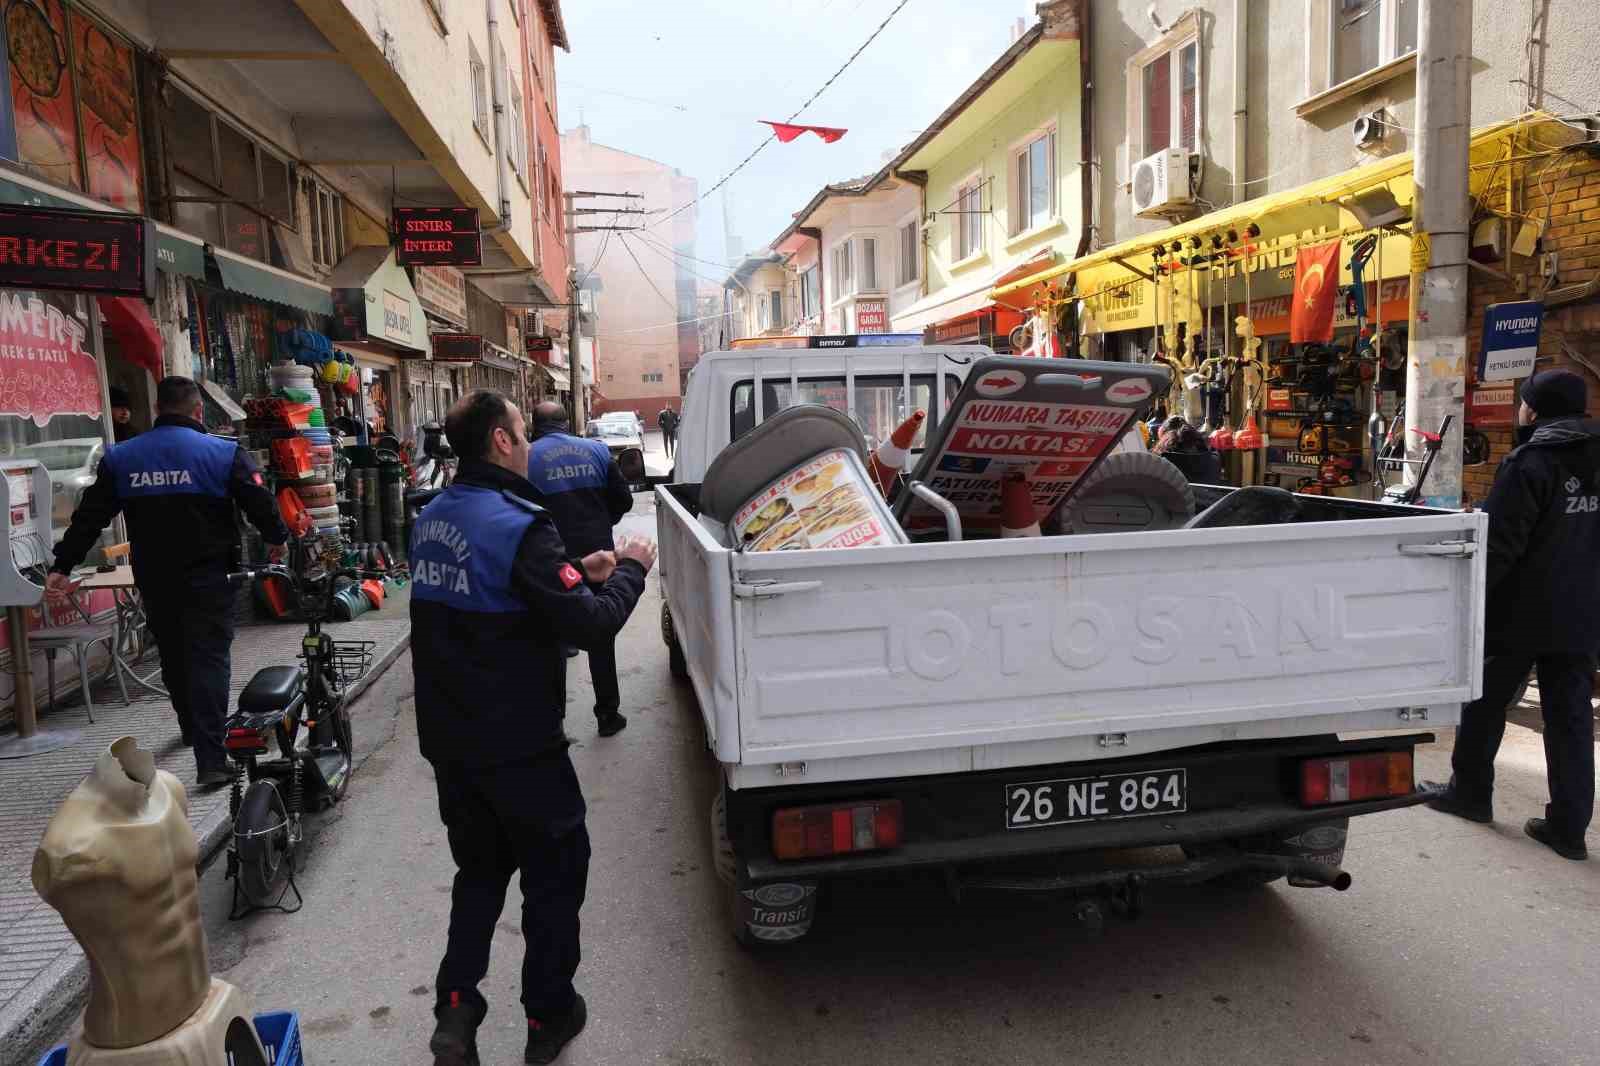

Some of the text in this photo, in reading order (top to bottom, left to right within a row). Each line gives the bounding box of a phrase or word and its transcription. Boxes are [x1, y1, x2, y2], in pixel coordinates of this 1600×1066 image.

[406, 220, 453, 233] SINIRS
[1496, 316, 1538, 331] HYUNDAI
[37, 348, 68, 364] TATLI
[964, 404, 1128, 431] NUMARA TAŞIMA
[966, 433, 1093, 454] NOKTASI
[129, 470, 193, 488] ZABITA
[545, 463, 597, 481] ZABITA
[929, 475, 999, 491] FATURA
[1565, 495, 1599, 514] ZAB
[903, 583, 1335, 682] OTOSAN
[1011, 774, 1182, 823] 26 NE 864
